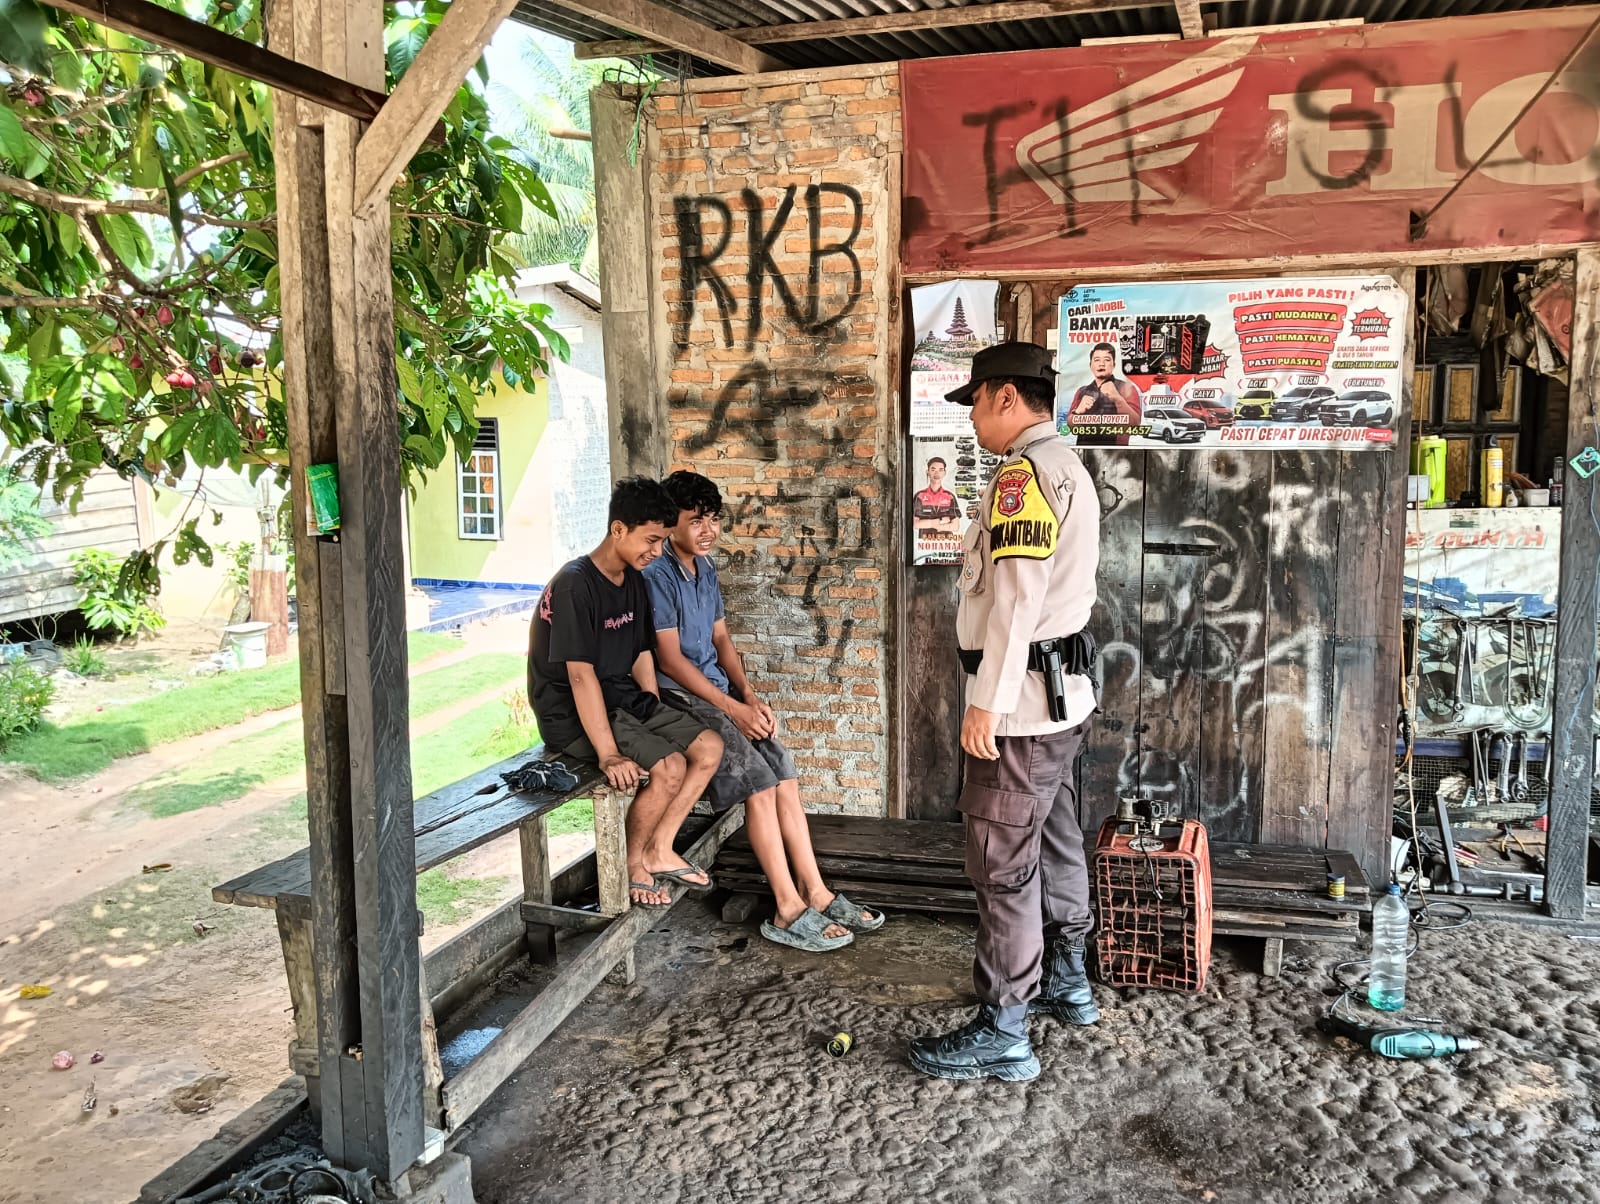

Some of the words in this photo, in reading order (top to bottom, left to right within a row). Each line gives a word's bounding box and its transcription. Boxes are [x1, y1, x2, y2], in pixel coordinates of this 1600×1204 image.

[673, 182, 863, 349] RKB
[1228, 291, 1262, 303] PILIH
[1266, 288, 1303, 299] YANG
[1307, 288, 1347, 300] PASTI
[1068, 305, 1091, 317] CARI
[1094, 300, 1126, 313] MOBIL
[1241, 312, 1272, 323] PASTI
[1274, 310, 1339, 322] MUDAHNYA
[1360, 317, 1382, 325] HARGA
[1069, 317, 1126, 331] BANYA
[1353, 325, 1388, 334] TERMURAH
[1068, 332, 1118, 343] TOYOTA
[1245, 334, 1273, 344] PASTI
[1275, 333, 1330, 343] HEMATNYA
[1248, 358, 1276, 367] PASTI
[1277, 357, 1322, 367] PUASNYA
[1354, 361, 1374, 369] TANYA
[1247, 380, 1268, 388] AGYA
[1298, 376, 1320, 385] RUSH
[1347, 378, 1383, 387] FORTUNER
[1193, 390, 1215, 398] CALYA
[1148, 396, 1177, 405] INNOVA
[1073, 415, 1101, 424] CANDRA
[1102, 415, 1129, 424] TOYOTA
[1072, 426, 1097, 435] 0853
[1099, 426, 1124, 435] 7544
[1125, 426, 1152, 435] 4657
[1220, 428, 1256, 441] PASTI
[1258, 428, 1296, 441] CEPAT
[1298, 427, 1366, 441] DIRESPON!
